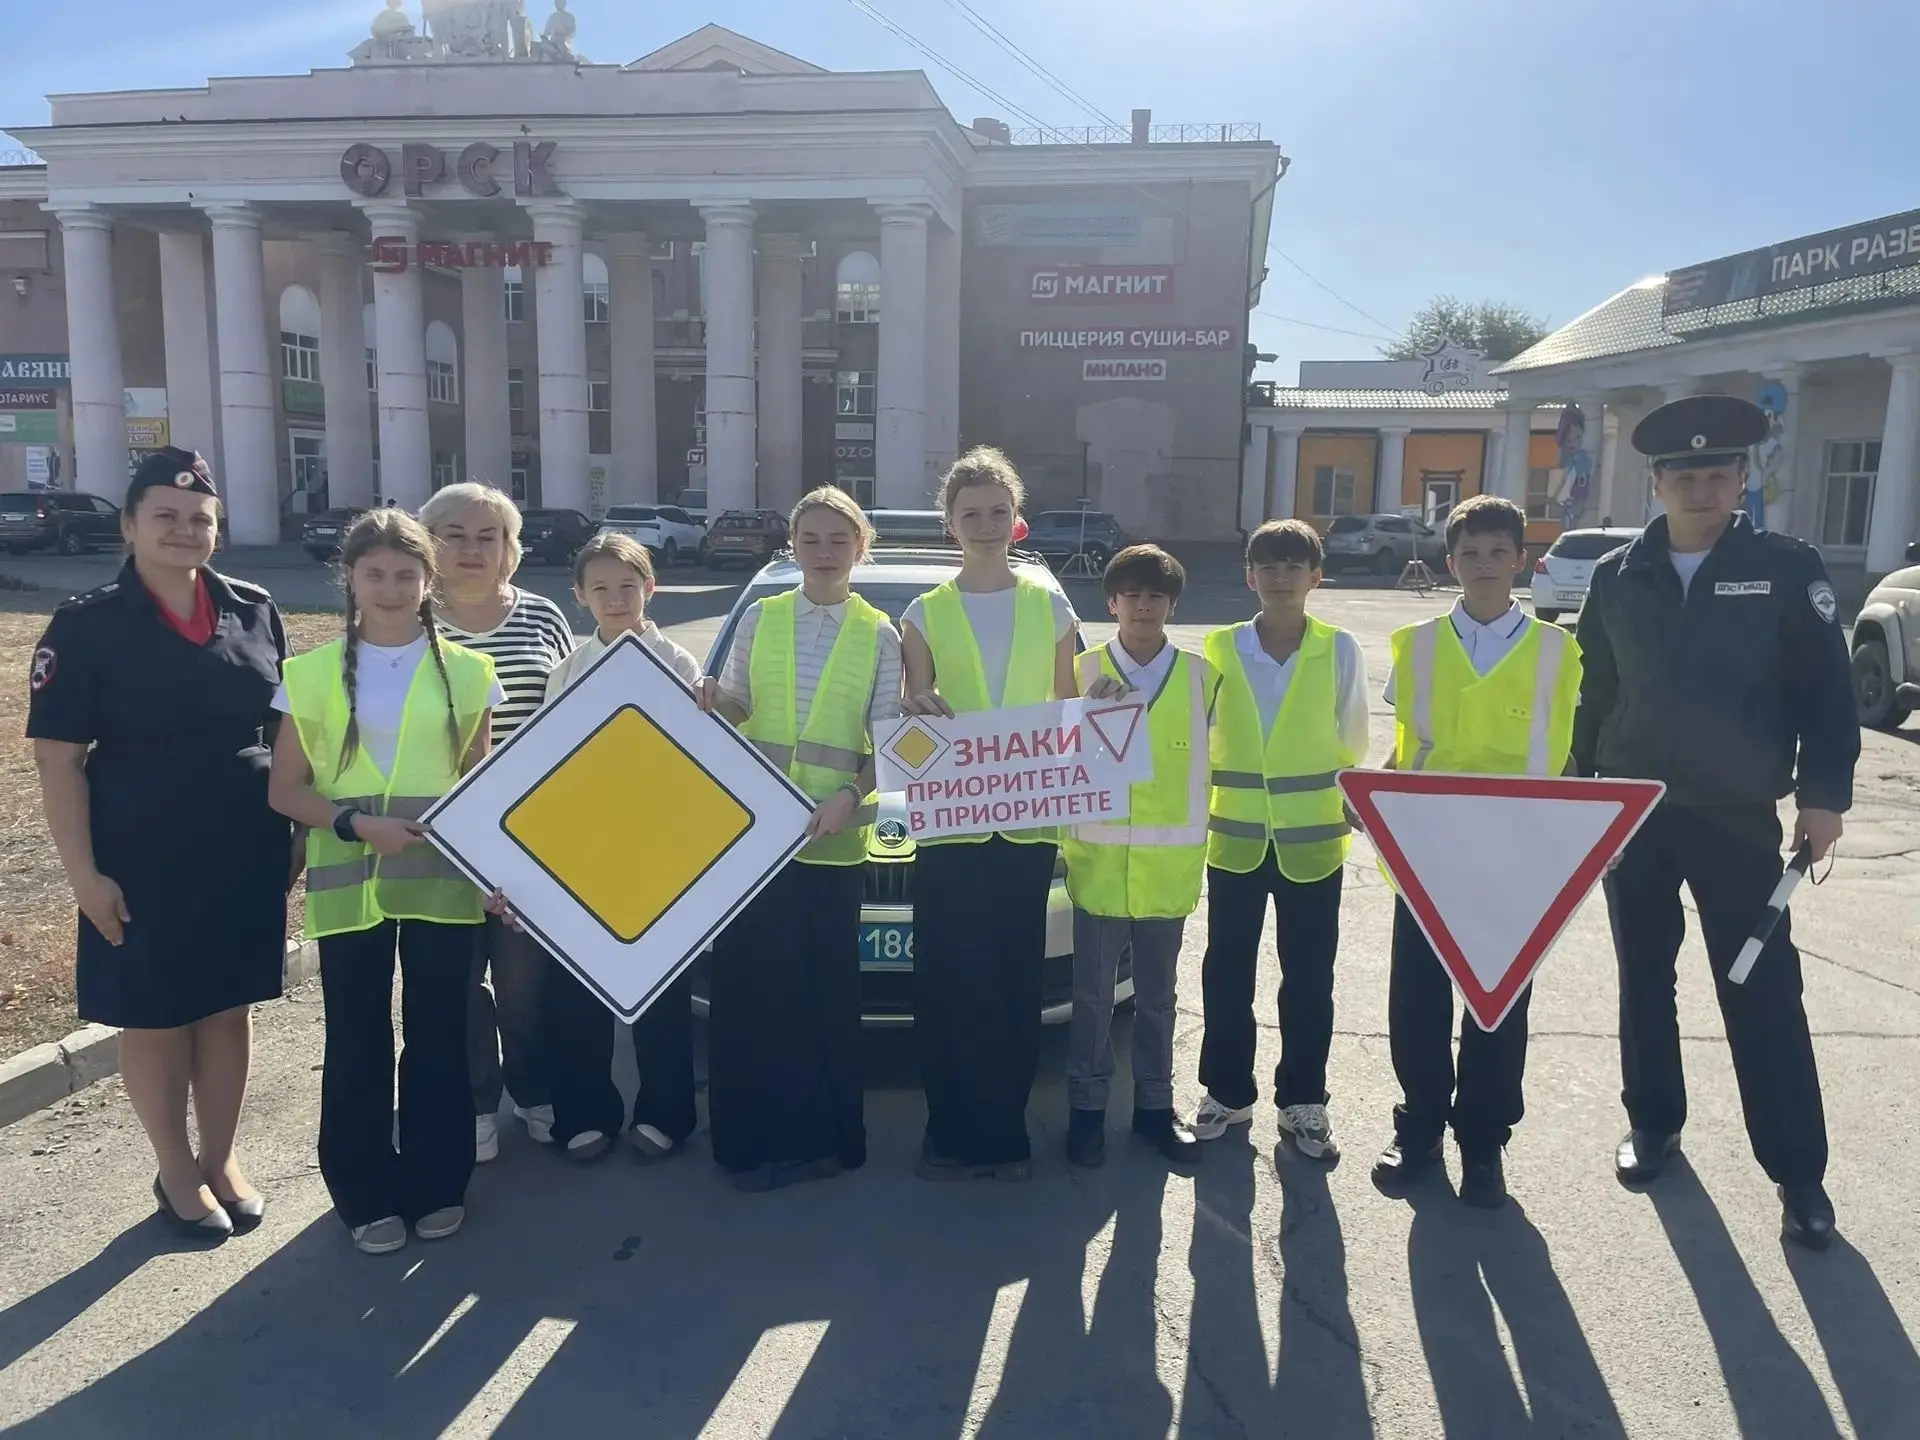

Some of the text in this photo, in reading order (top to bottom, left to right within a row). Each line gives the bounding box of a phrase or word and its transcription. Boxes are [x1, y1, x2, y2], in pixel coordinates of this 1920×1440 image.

[341, 141, 567, 198] ОРСК
[416, 240, 553, 268] МАГНИТ
[1772, 243, 1842, 282] ПАРК
[1064, 274, 1168, 295] МАГНИТ
[1020, 329, 1231, 348] ПИЦЦЕРИЯ СУШИ-БАР
[1085, 361, 1164, 378] МИЛАНО
[835, 446, 876, 458] OZO
[953, 724, 1082, 767] ЗНАКИ
[907, 764, 1090, 803] ПРИОРИТЕТА
[910, 790, 1113, 832] В ПРИОРИТЕТЕ
